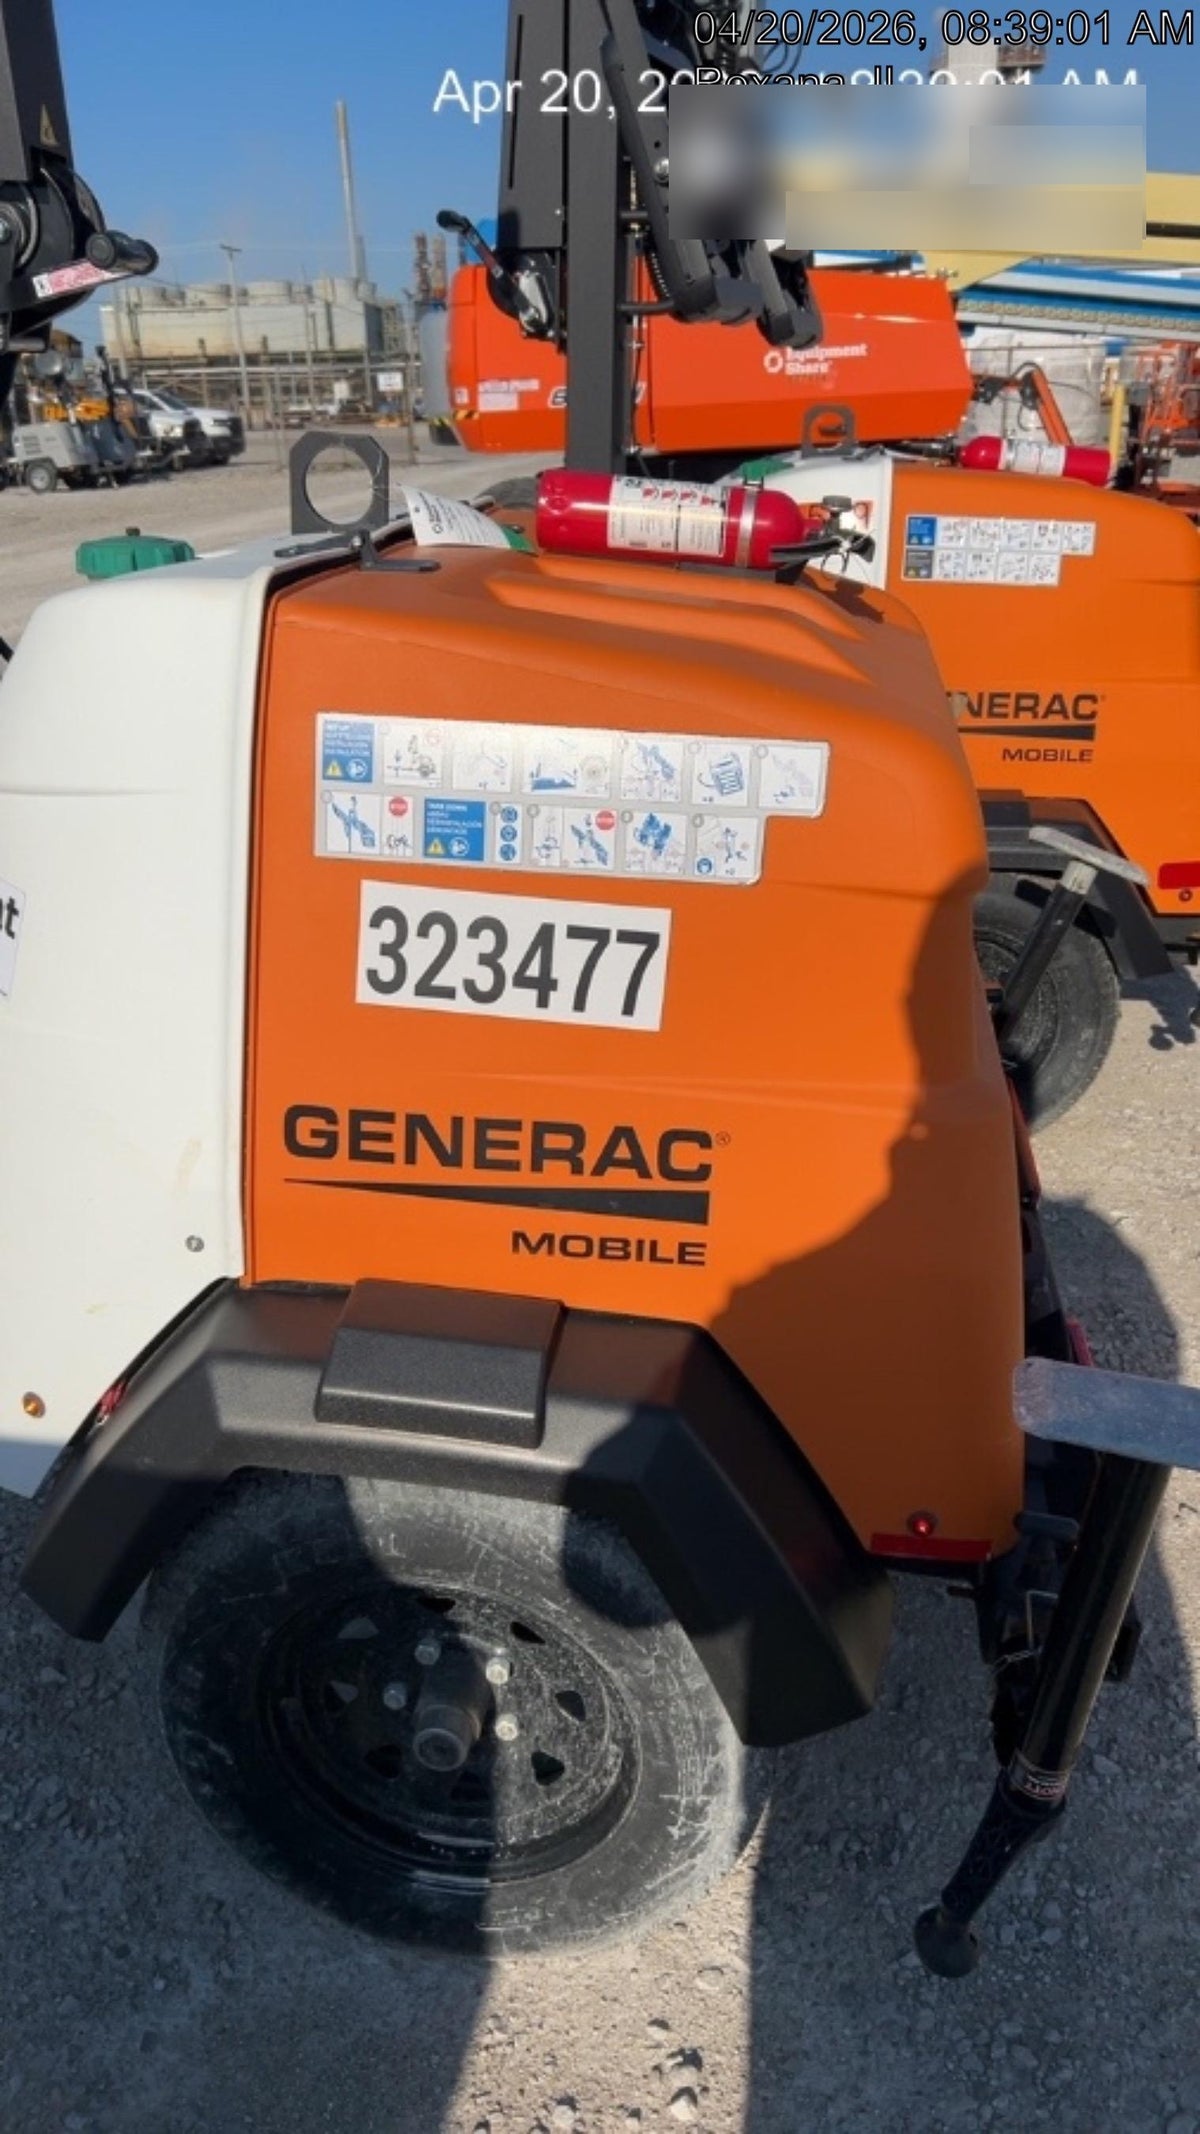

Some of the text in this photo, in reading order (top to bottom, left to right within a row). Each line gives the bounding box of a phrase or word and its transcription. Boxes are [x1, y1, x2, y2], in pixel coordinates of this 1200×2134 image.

[946, 692, 1098, 720] NERAC
[1002, 749, 1092, 762] MOBILE
[366, 905, 660, 1017] 323477
[284, 1104, 712, 1182] GENERAC
[511, 1230, 707, 1266] MOBILE
